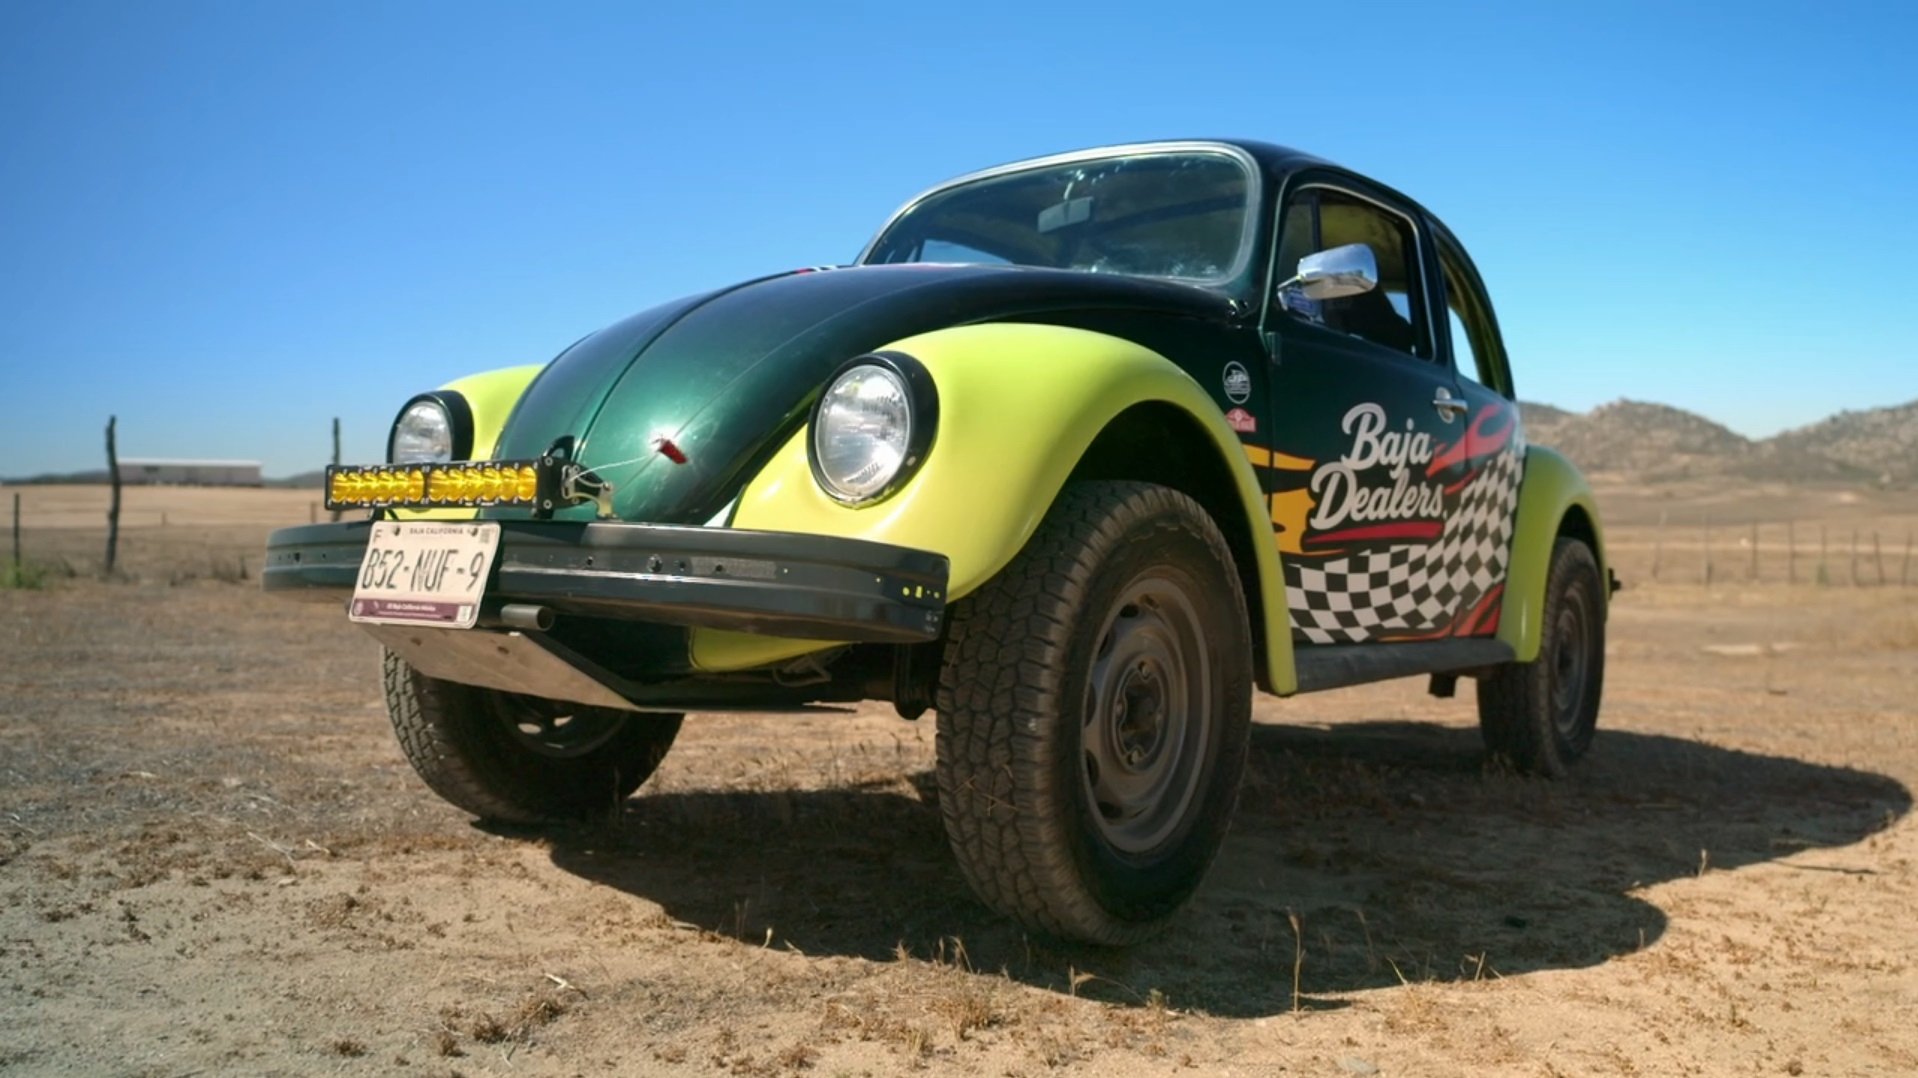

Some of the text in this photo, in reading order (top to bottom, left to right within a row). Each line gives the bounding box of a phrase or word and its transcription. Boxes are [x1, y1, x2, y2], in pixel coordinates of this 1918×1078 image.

[1341, 402, 1432, 480] Baja
[409, 527, 464, 535] BAJA CALIFORNIA
